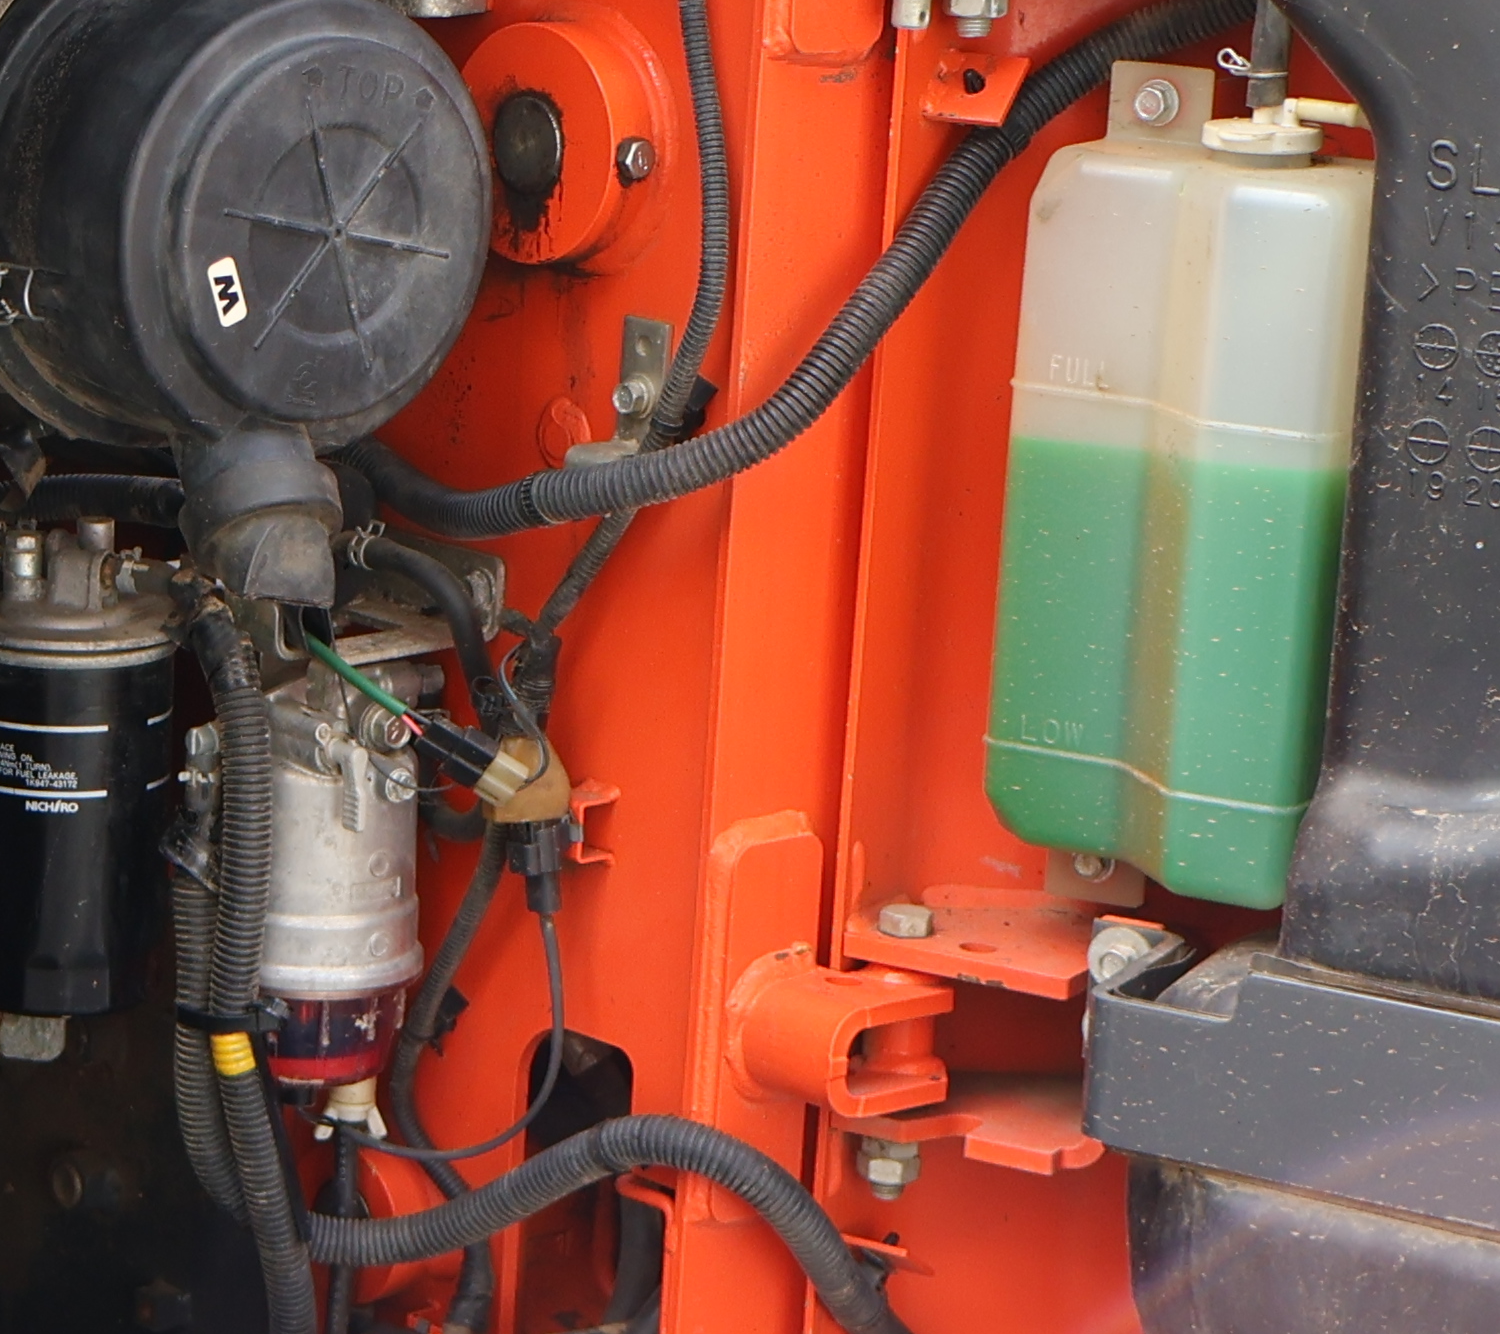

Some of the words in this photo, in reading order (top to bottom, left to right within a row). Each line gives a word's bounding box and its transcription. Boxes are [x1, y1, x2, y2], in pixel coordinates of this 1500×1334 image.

[336, 64, 405, 110] TOP
[1416, 373, 1455, 407] 14
[1408, 468, 1445, 500] 19
[1020, 714, 1086, 745] LOW
[15, 769, 34, 779] FUEL
[25, 799, 79, 813] NICHIRO
